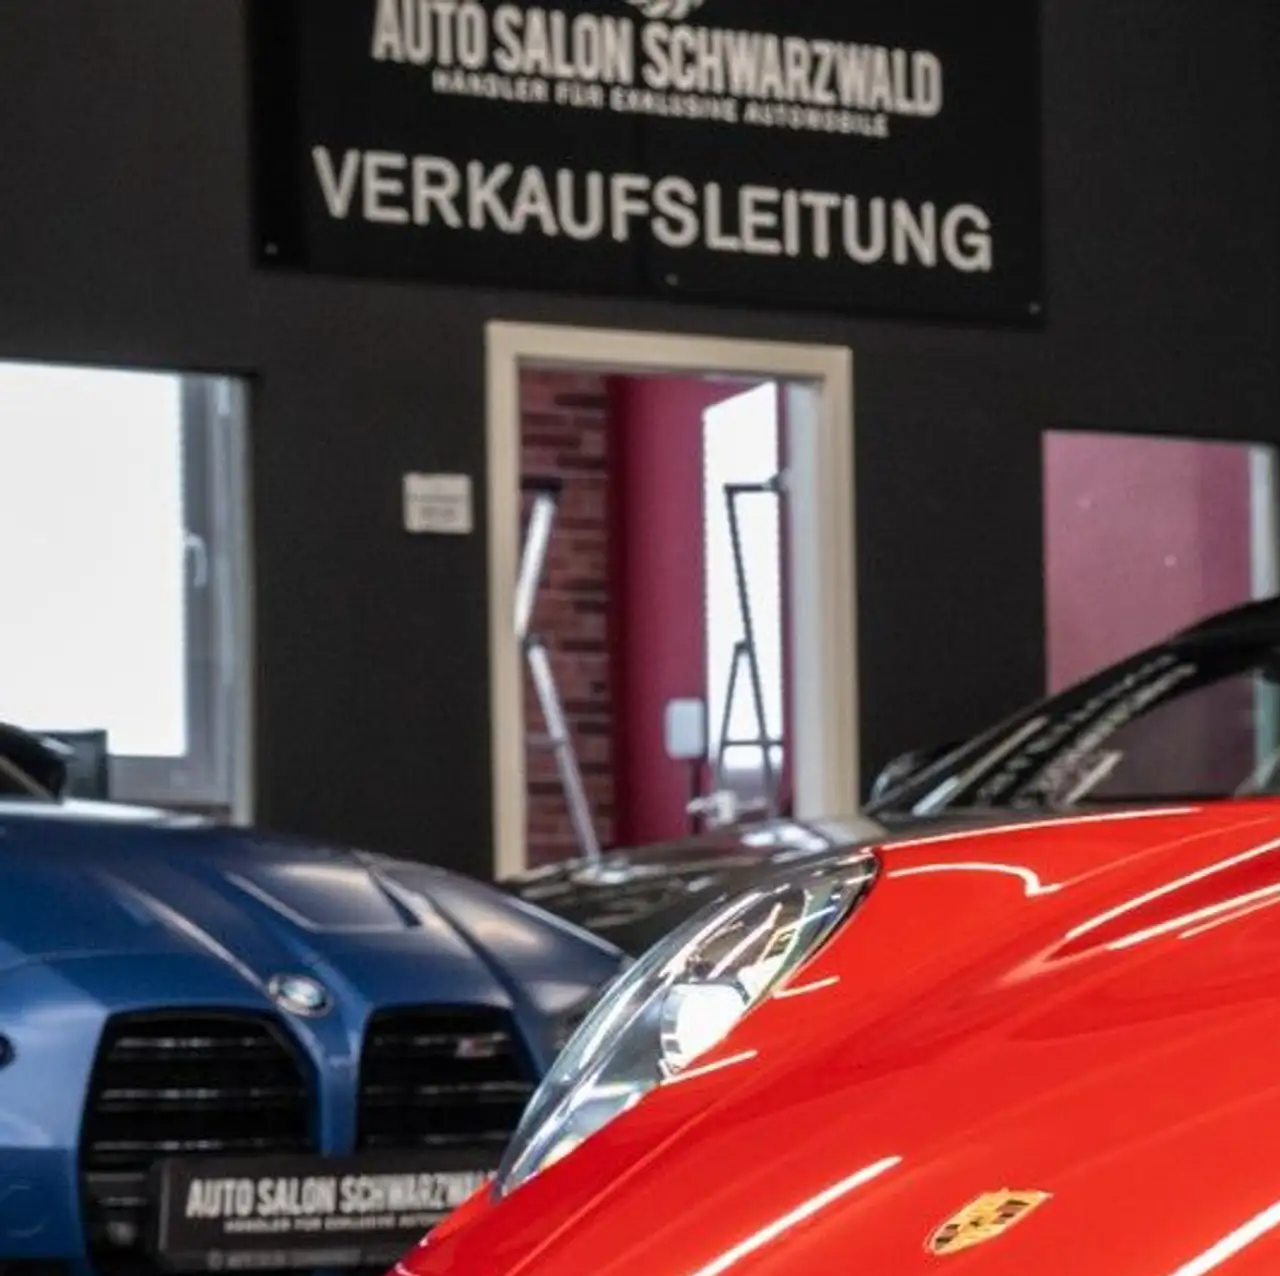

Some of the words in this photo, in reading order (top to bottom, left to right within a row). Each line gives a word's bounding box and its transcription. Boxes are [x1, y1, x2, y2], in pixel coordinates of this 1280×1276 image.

[370, 0, 488, 69] AUTO
[492, 4, 634, 85] SALON
[641, 21, 943, 117] SCHWARZWALD
[311, 146, 993, 272] VERKAUFSLEITUNG
[185, 1177, 255, 1219] AUTO
[256, 1176, 337, 1217] SALON
